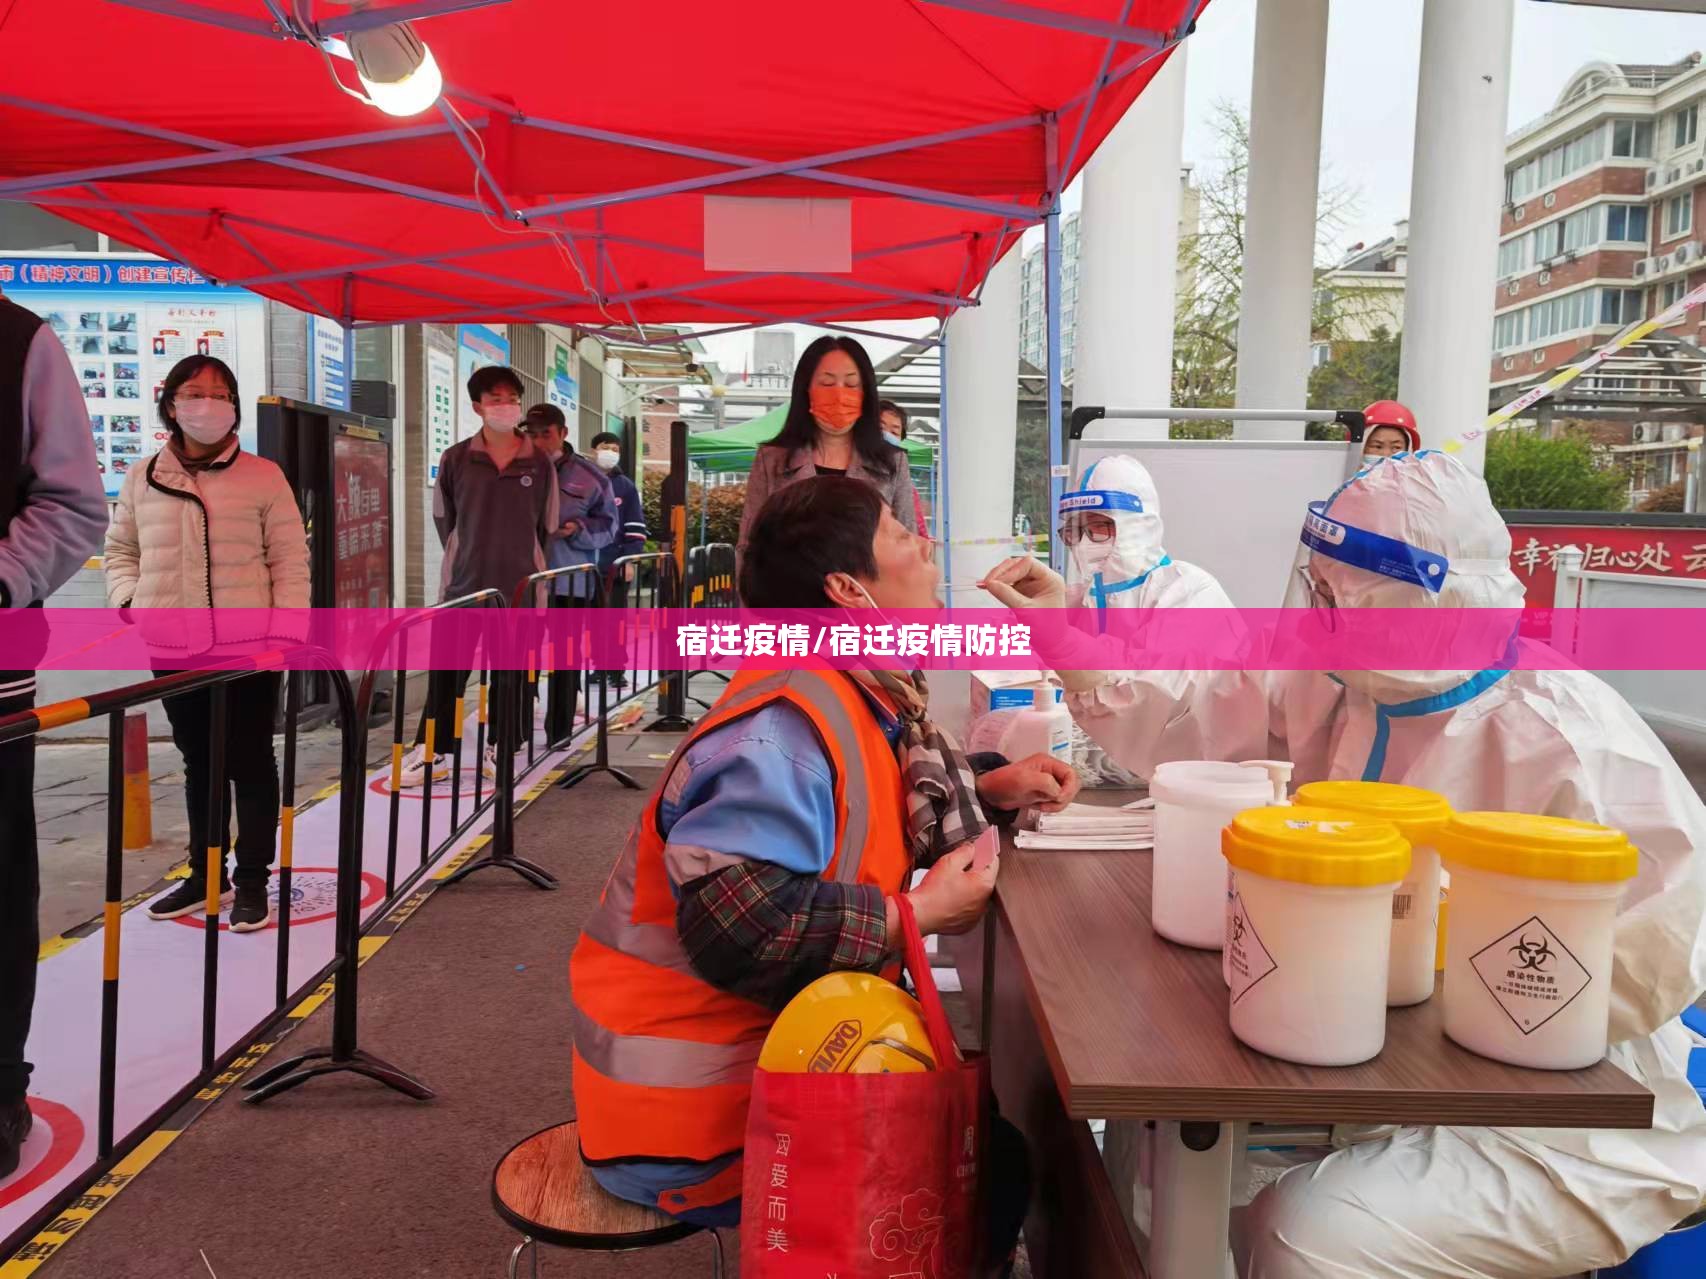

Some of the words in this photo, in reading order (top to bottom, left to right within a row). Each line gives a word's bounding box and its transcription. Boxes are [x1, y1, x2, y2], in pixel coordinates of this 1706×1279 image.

[1506, 970, 1555, 985] 感染性物质
[766, 1132, 792, 1254] 因爱而美
